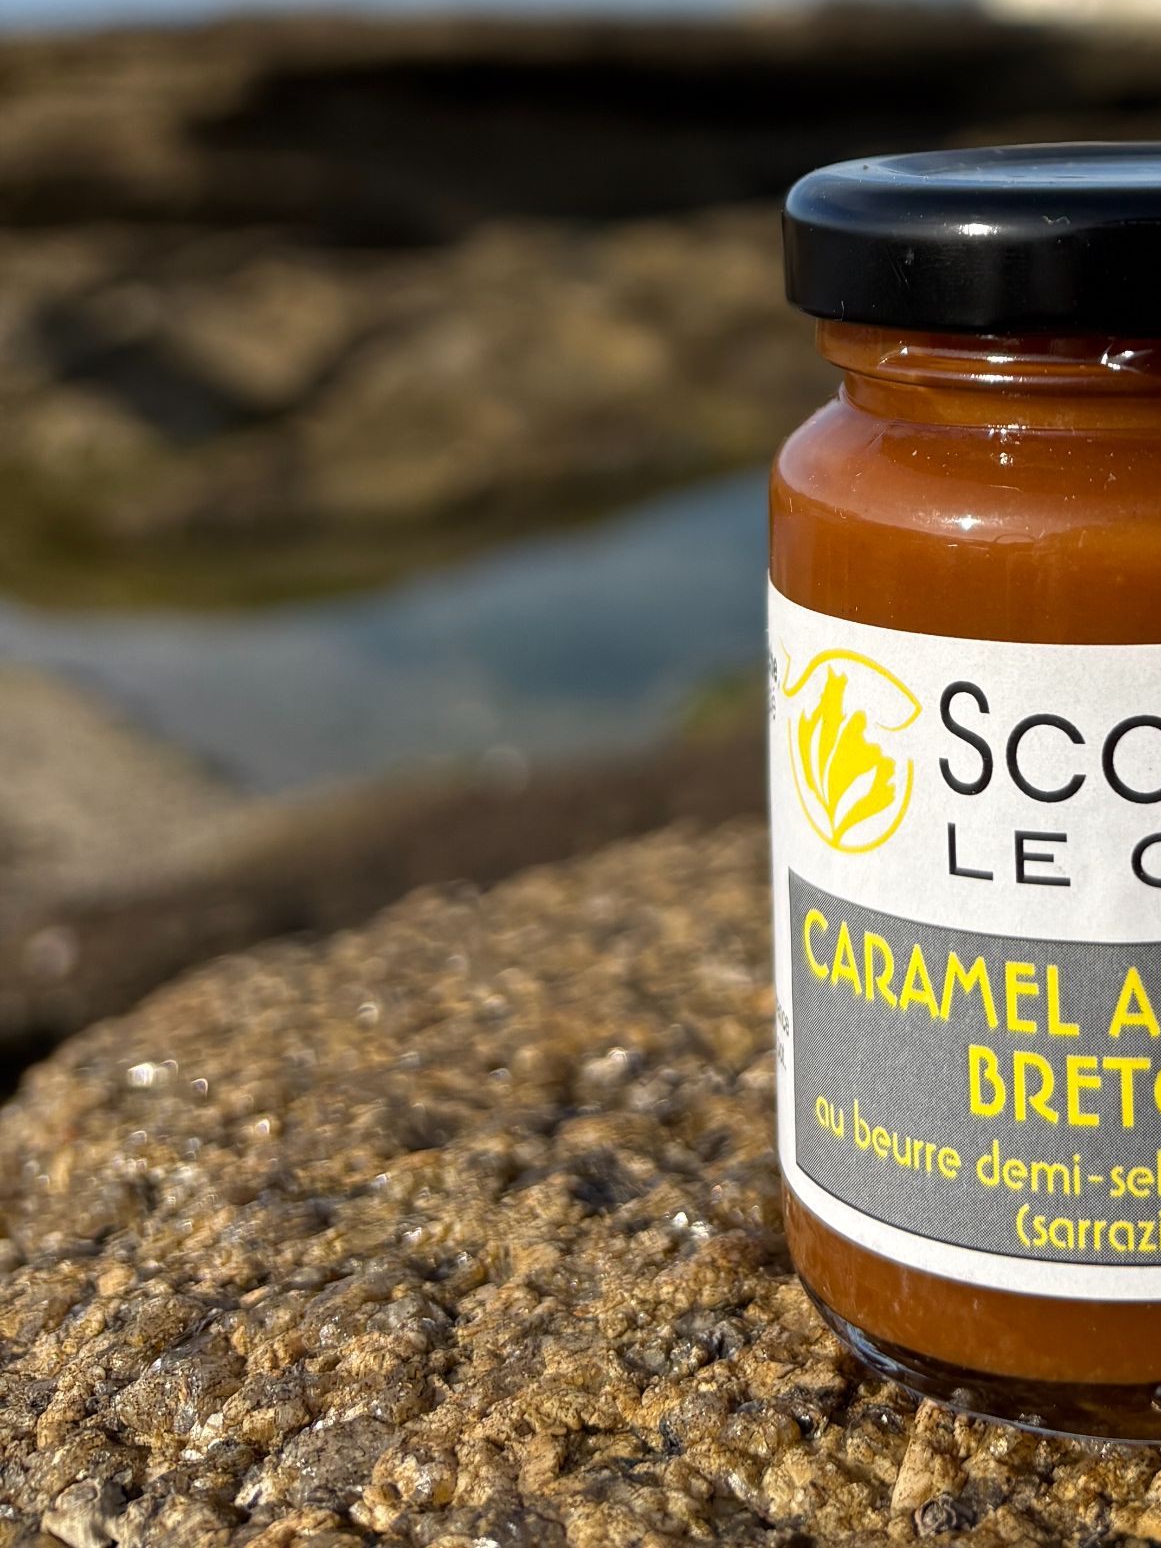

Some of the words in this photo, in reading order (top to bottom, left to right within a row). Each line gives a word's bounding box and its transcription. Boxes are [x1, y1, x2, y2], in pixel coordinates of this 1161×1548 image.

[946, 822, 1073, 888] LE
[802, 908, 1082, 1040] CARAMEL
[814, 1095, 846, 1140] au
[853, 1100, 963, 1182] beurre
